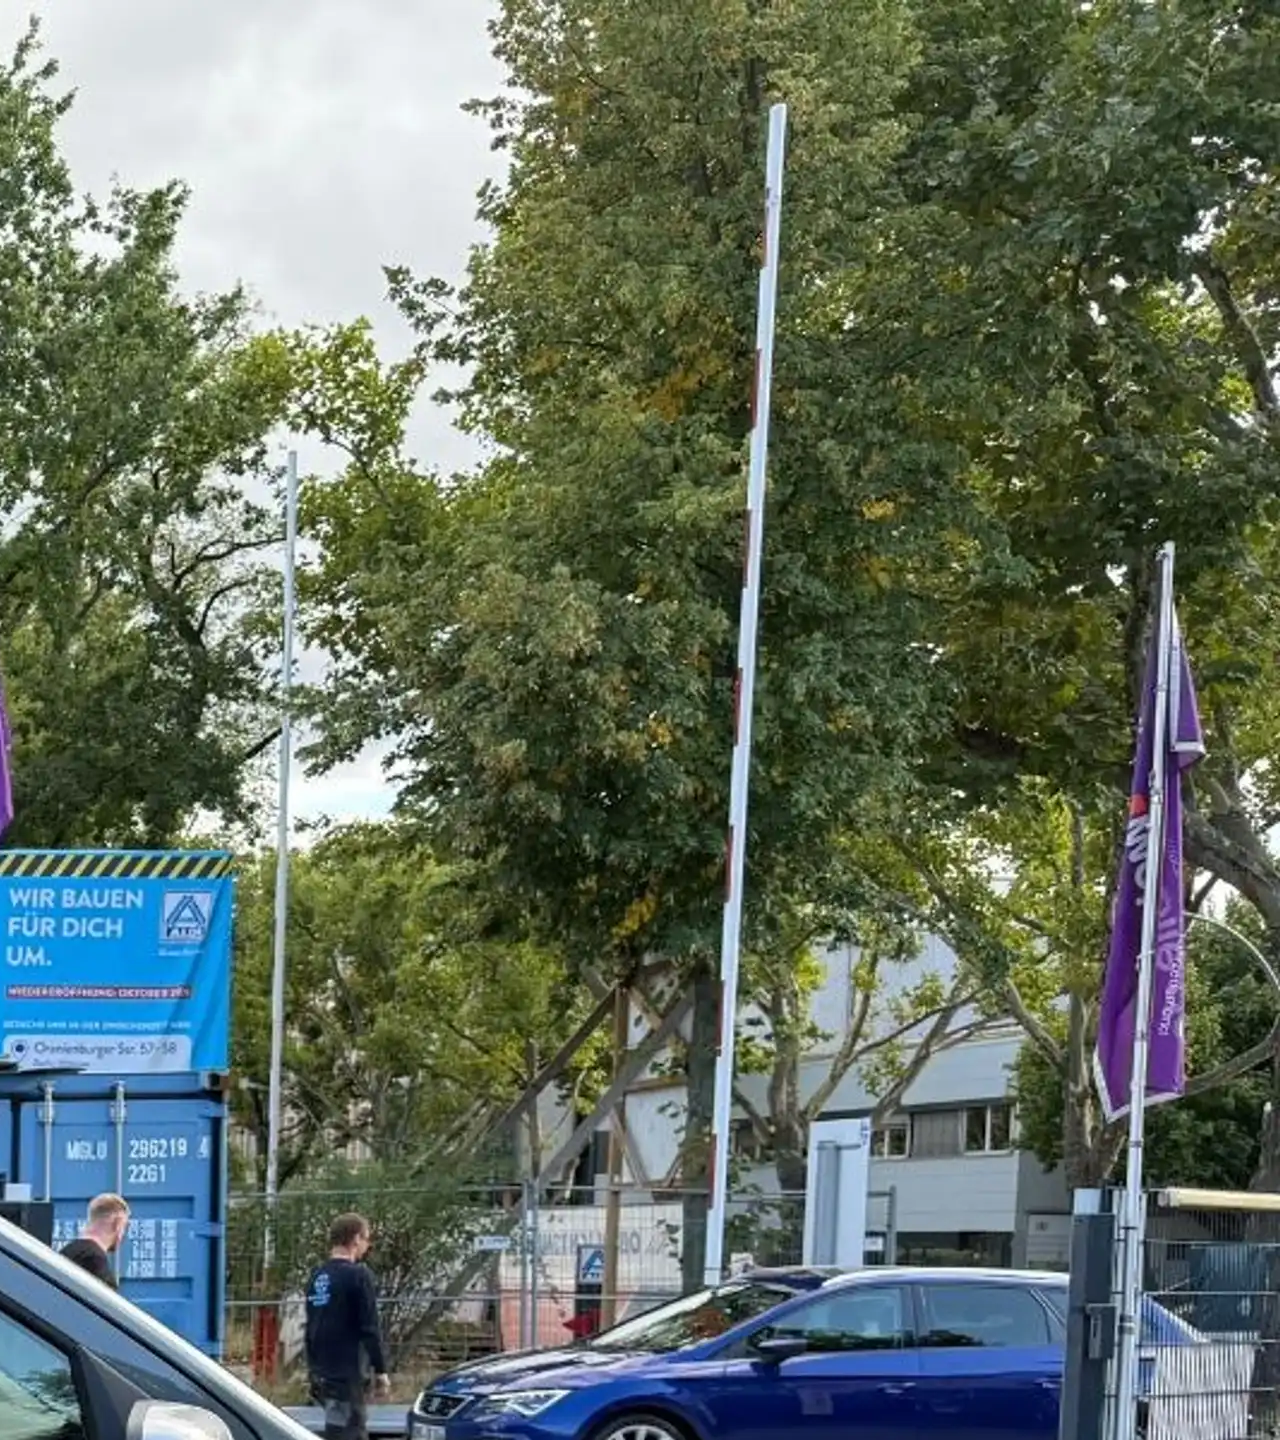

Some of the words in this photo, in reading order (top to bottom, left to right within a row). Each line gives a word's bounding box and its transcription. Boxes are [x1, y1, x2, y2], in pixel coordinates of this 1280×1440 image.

[9, 888, 55, 909] WIR
[62, 888, 144, 909] BAUEN
[7, 911, 56, 938] FÜR
[62, 917, 123, 938] DICH
[6, 945, 53, 967] UM.
[129, 1137, 188, 1159] 296219
[128, 1163, 167, 1183] 22G1
